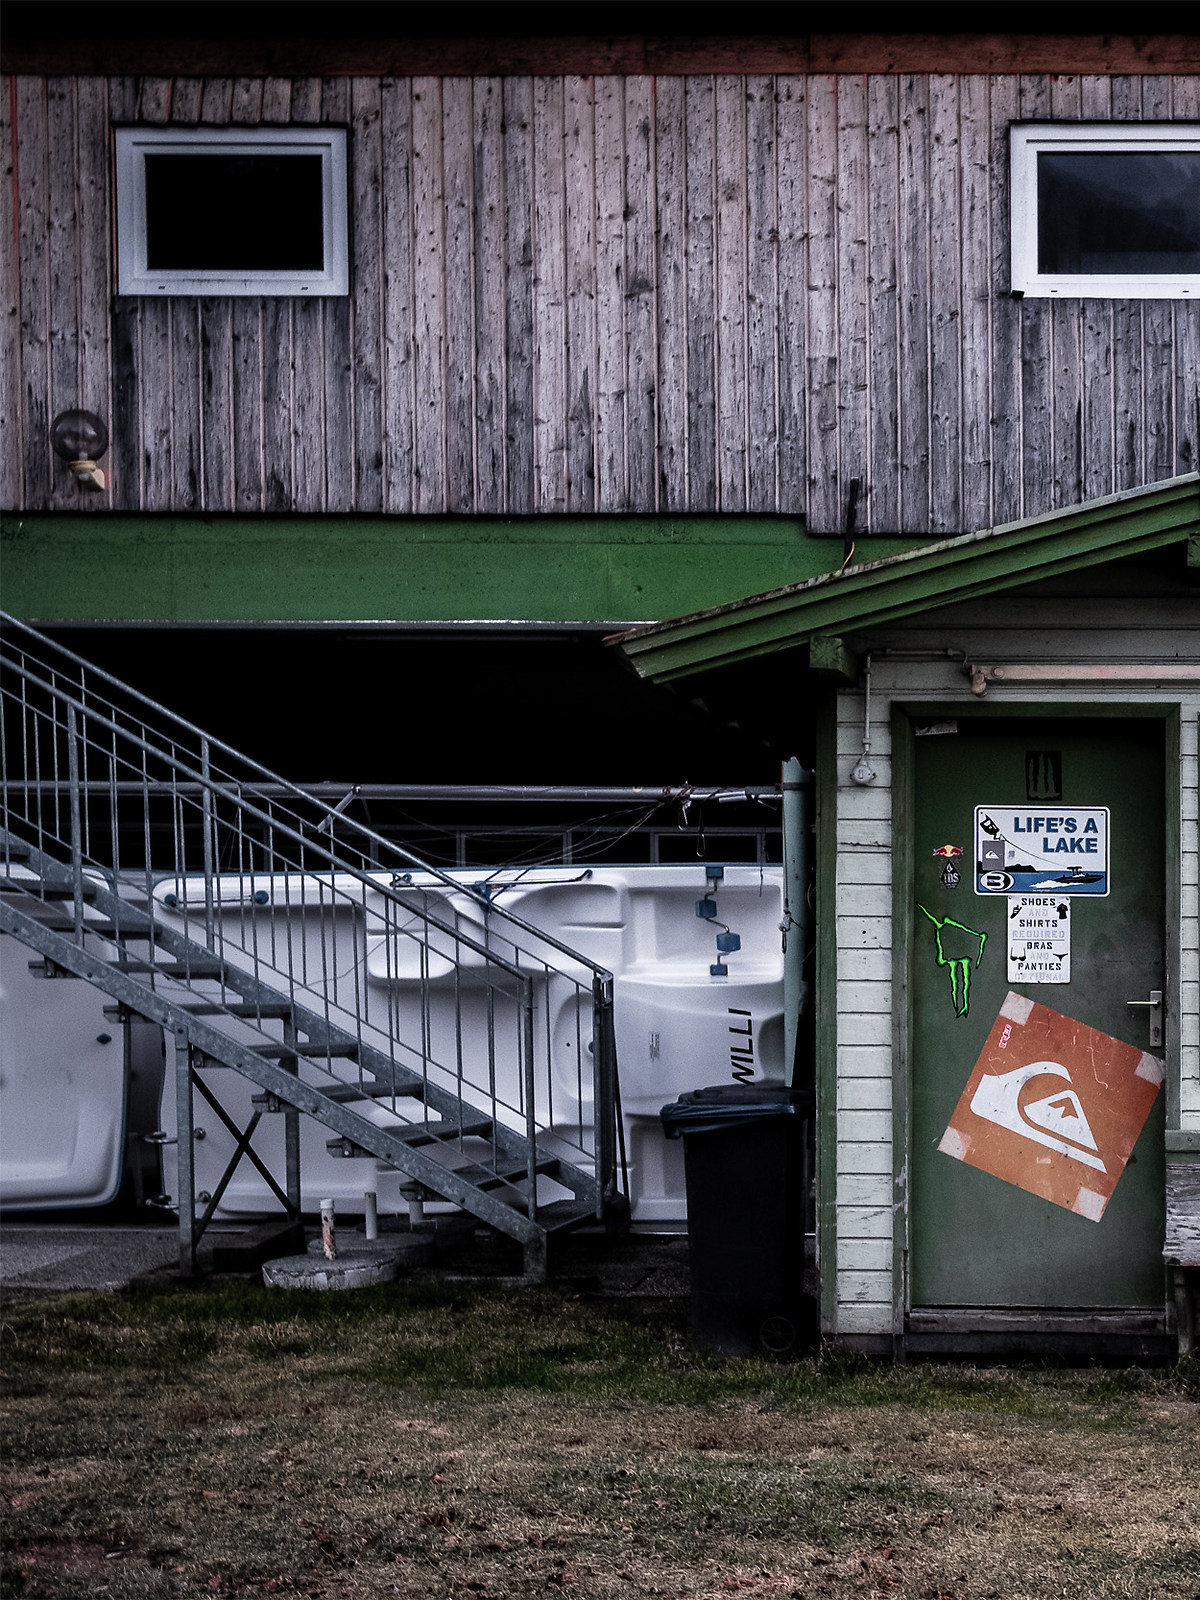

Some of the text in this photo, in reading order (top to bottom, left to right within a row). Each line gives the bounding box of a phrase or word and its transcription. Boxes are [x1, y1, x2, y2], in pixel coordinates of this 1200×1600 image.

[1014, 817, 1098, 833] LIFE'S A
[1042, 837, 1098, 853] LAKE
[1021, 898, 1056, 906] SHOES
[1028, 909, 1048, 917] AND
[1019, 919, 1058, 928] SHIRTS
[1012, 930, 1065, 938] REQUIRED
[1026, 942, 1053, 950] BRAS
[1030, 952, 1050, 960] AND
[1017, 962, 1062, 971] PANTIES
[728, 1008, 755, 1086] WILLI
